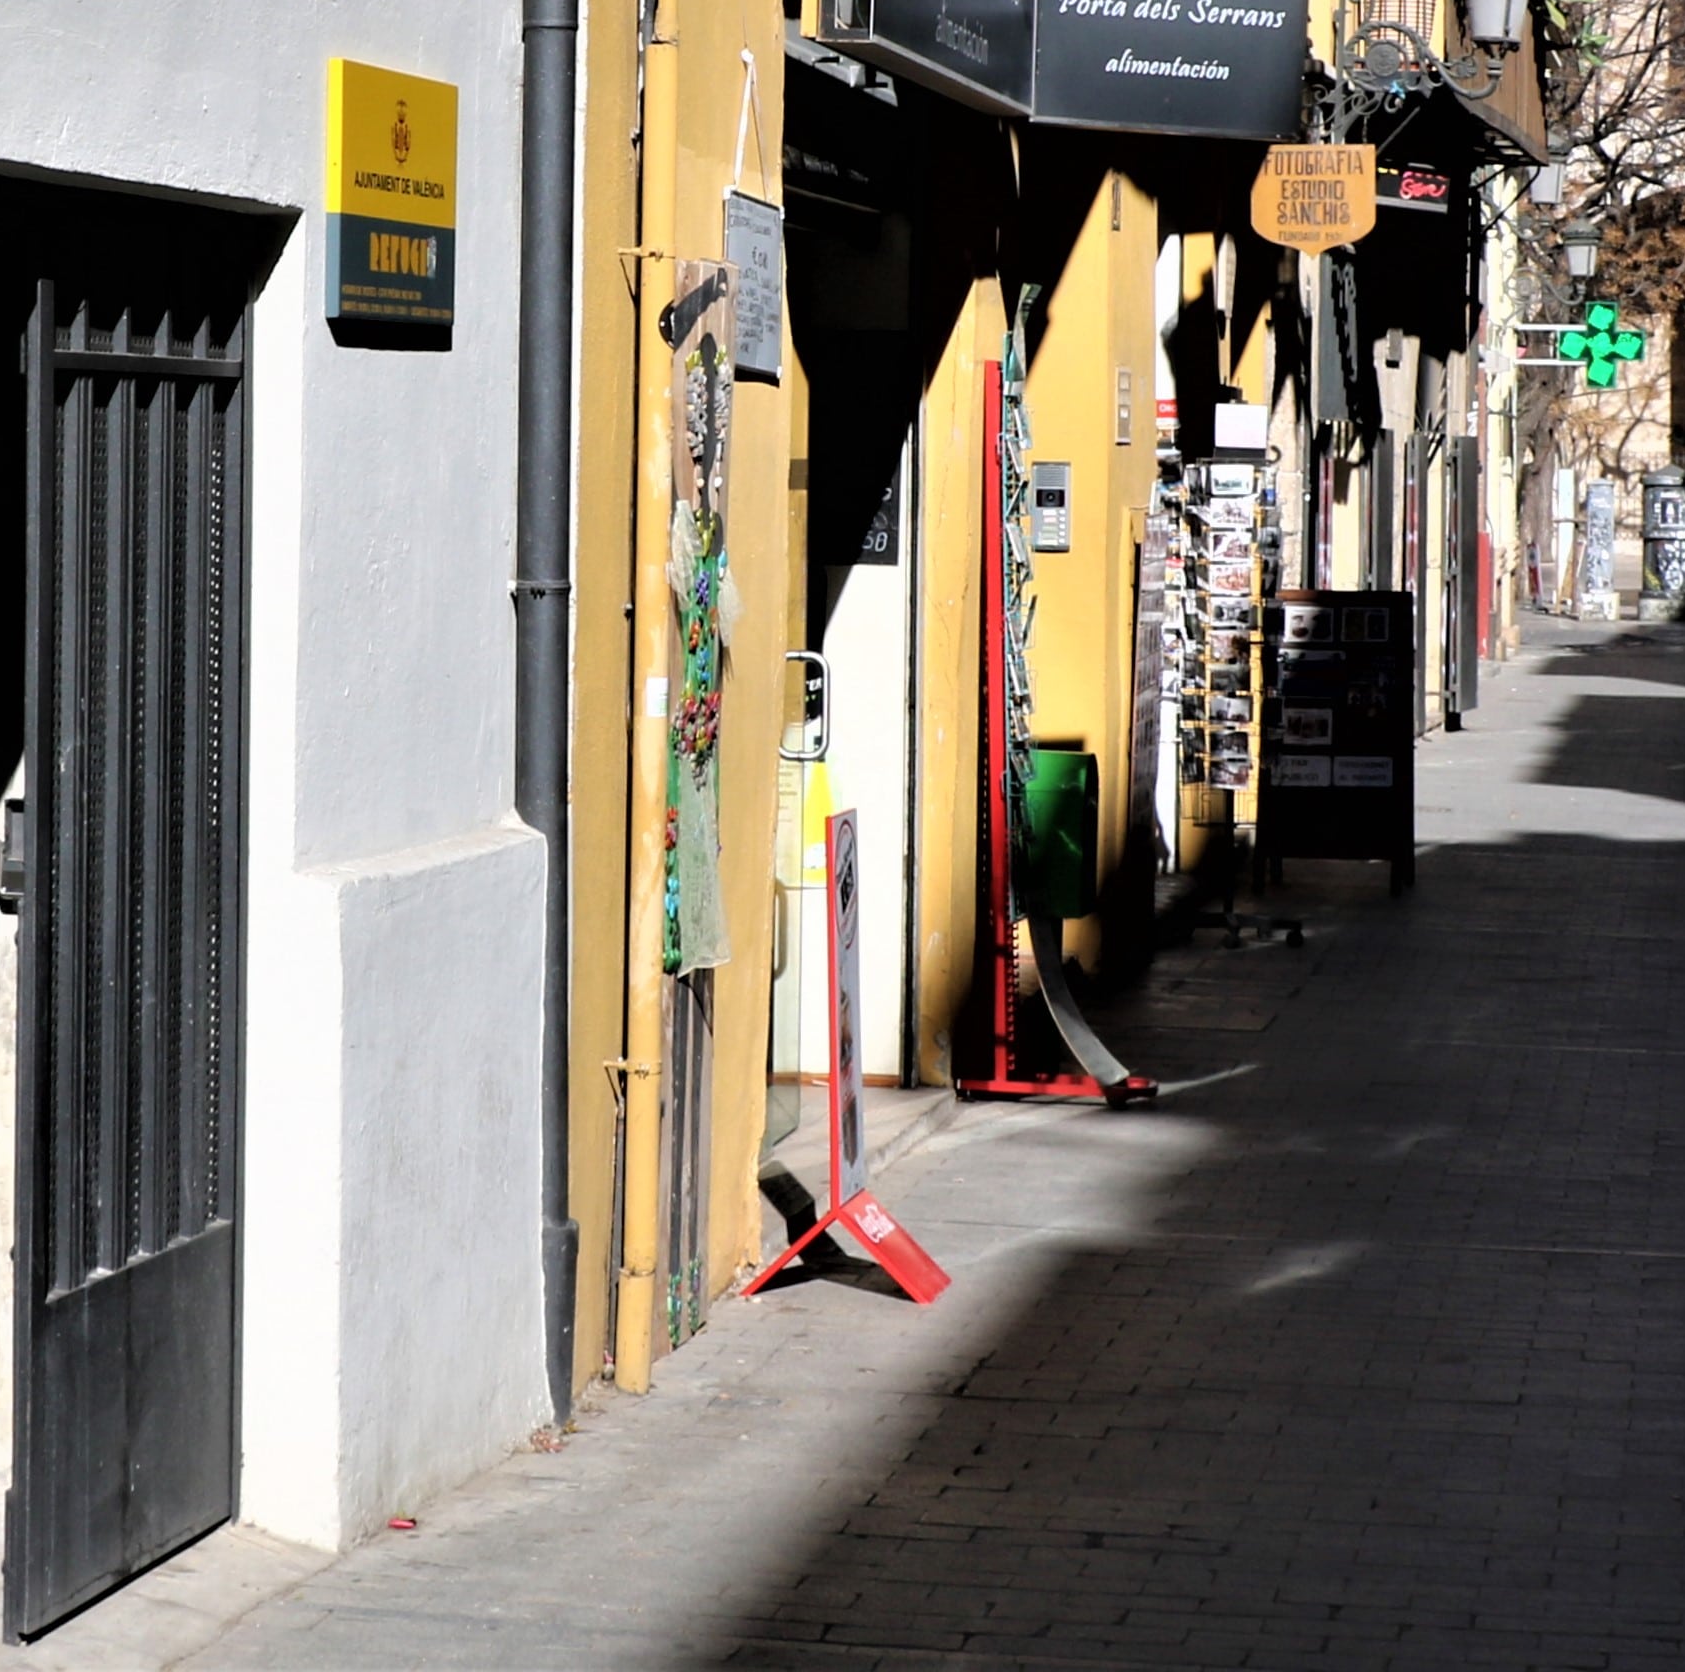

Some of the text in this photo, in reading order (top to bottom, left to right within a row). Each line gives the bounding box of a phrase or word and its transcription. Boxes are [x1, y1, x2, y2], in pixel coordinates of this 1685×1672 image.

[1105, 48, 1230, 80] alimentación
[1265, 150, 1364, 176] FOTOGRAFIA
[354, 170, 400, 193] AJUNTAMENT
[401, 177, 411, 195] DE
[1281, 179, 1345, 201] ESTUDIO
[1277, 201, 1350, 226] SANCHIS
